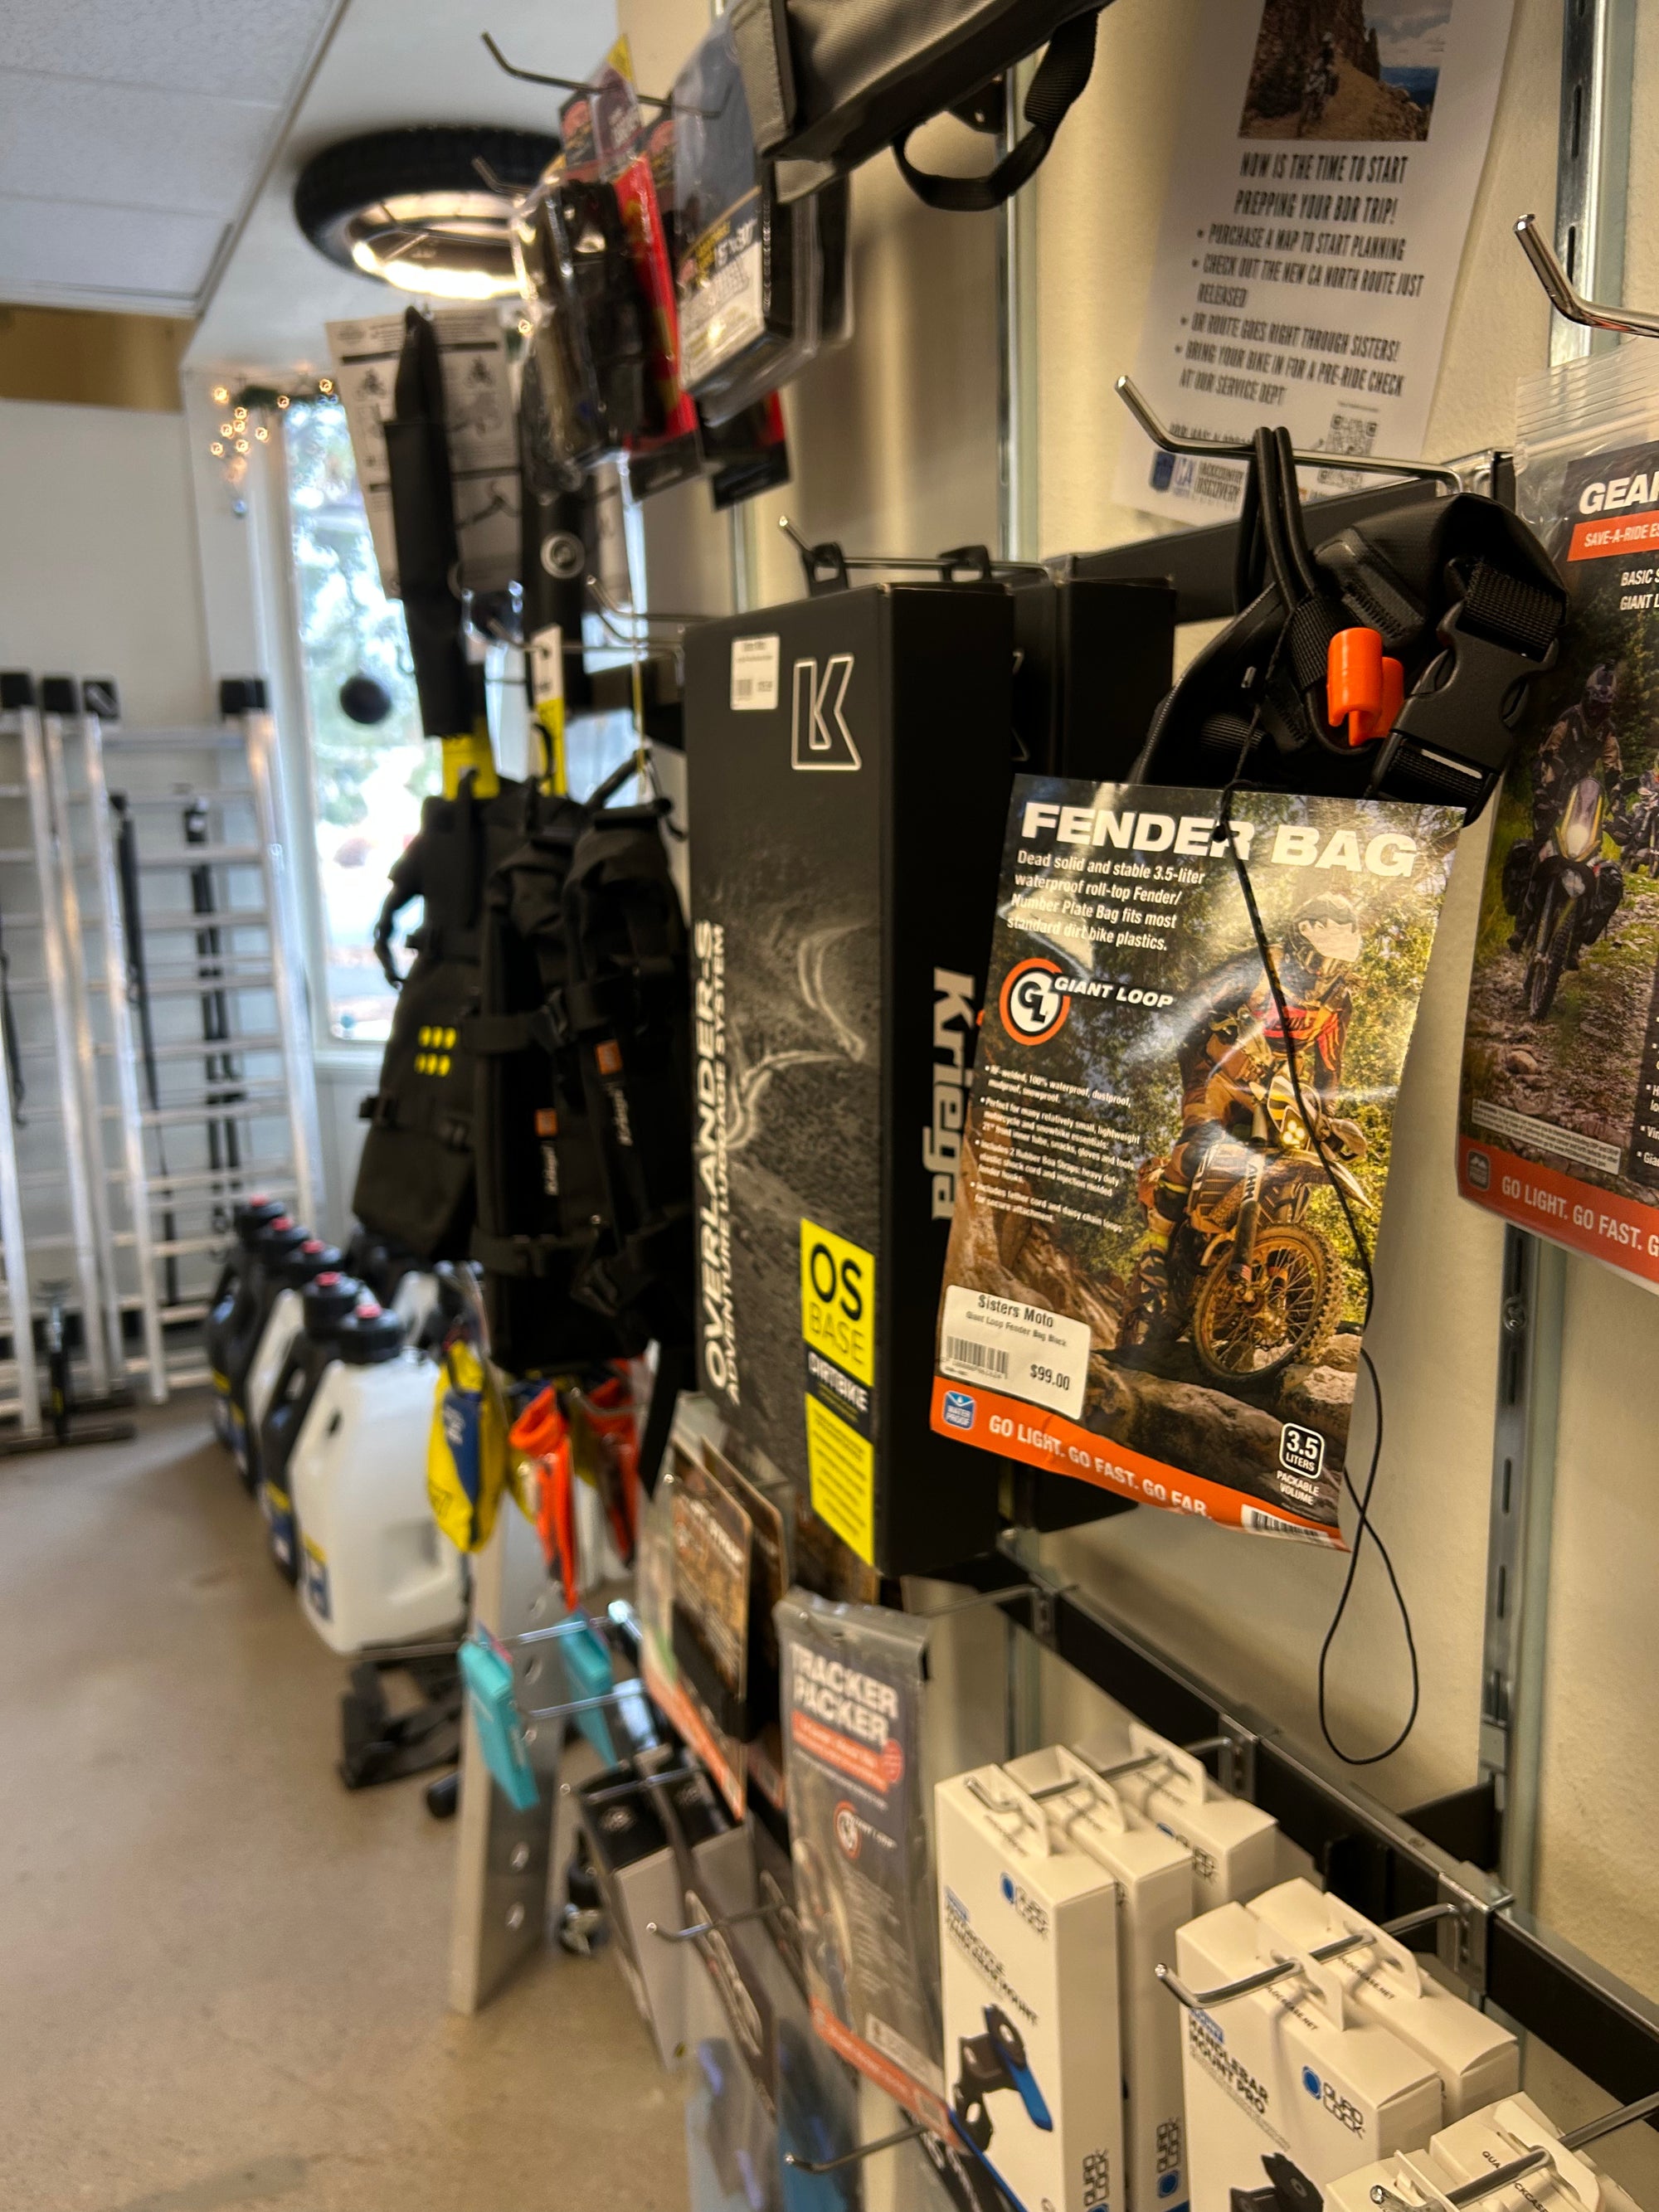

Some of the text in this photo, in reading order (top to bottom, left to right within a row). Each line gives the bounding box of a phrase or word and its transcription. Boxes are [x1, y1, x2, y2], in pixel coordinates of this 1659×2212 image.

[1240, 153, 1408, 183] NOW IS THE TIME TO START
[1234, 190, 1297, 217] PREPPING
[1299, 194, 1332, 220] YOUR
[1362, 197, 1399, 225] TRIP!
[1209, 223, 1406, 261] PURCHASE A MAP TO START PLANNING
[1203, 253, 1424, 297] CHECK OUT THE NEW CA NORTH ROUTE JUST
[1197, 283, 1247, 308] RELEASED
[1207, 314, 1240, 338] ROUTE
[1241, 318, 1267, 342] GOES
[1267, 323, 1301, 348] RIGHT
[1301, 328, 1350, 355] THROUGH
[1350, 335, 1401, 362] SISTERS!
[1185, 340, 1404, 396] BRING YOUR BIKE IN FOR A PRE-RIDE CHECK
[1215, 375, 1259, 401] SERVICE
[1258, 382, 1287, 406] DEPT
[1584, 523, 1649, 547] SAVE-A-RIDE
[1621, 568, 1653, 587] BASIC
[1619, 593, 1653, 611] GIANT
[791, 652, 862, 771] K
[1021, 802, 1418, 878] FENDER BAG
[1017, 849, 1206, 885] Dead solid and stable 3.5-liter
[1014, 873, 1183, 906] waterproof roll-top Fender/
[1011, 893, 1177, 929] Number Plate Bag fits most
[1007, 916, 1168, 951] standard dirt bike plastics.
[1053, 975, 1174, 1009] GIANT LOOP
[922, 966, 975, 1221] Kriega
[1029, 1075, 1131, 1108] 100% waterproof, dustproof,
[1041, 1112, 1074, 1128] relatively
[1097, 1125, 1140, 1145] lightweight
[1501, 1176, 1520, 1199] GO
[1525, 1184, 1569, 1220] LIGHT.
[1573, 1205, 1593, 1230] GO
[1598, 1215, 1642, 1251] FAST.
[810, 1242, 863, 1321] OS
[978, 1294, 1053, 1328] Sisters Moto
[809, 1300, 865, 1366] BASE
[966, 1311, 1068, 1347] Giant Loop Fender Bag Black
[1029, 1364, 1070, 1391] $99.00
[989, 1415, 1014, 1437] GO
[1017, 1423, 1065, 1457] LIGHT.
[1068, 1446, 1091, 1468] GO
[1095, 1456, 1139, 1490] FAST.
[1142, 1479, 1166, 1501] GO
[1286, 1430, 1318, 1460] 3.5
[1286, 1452, 1315, 1471] LITERS
[1277, 1470, 1320, 1497] PACKABLE
[1280, 1482, 1314, 1506] VOLUME
